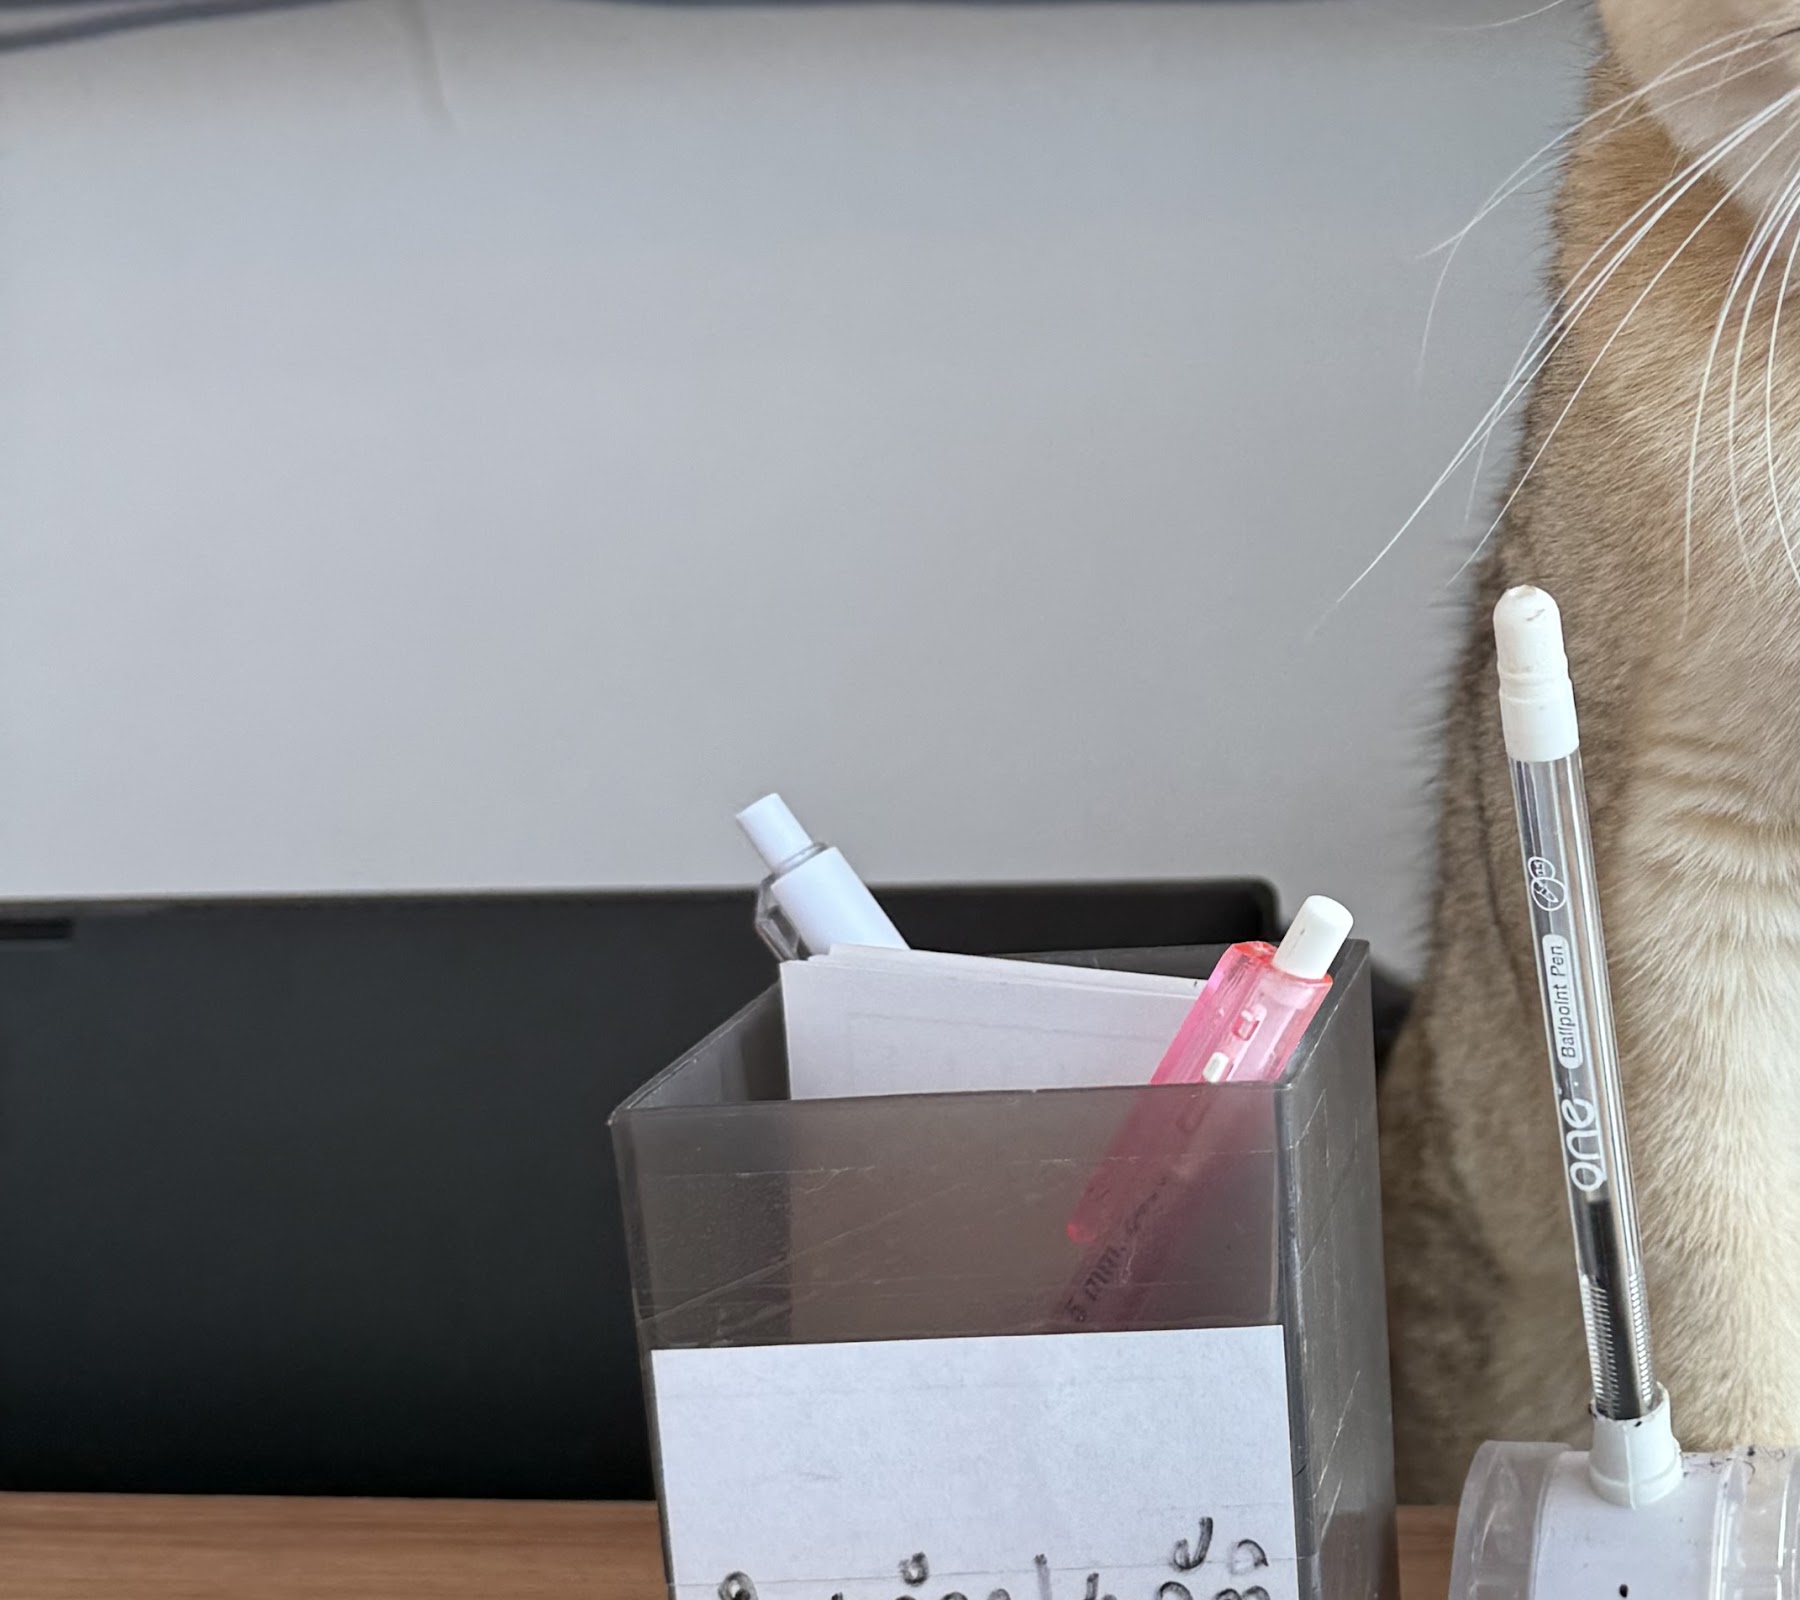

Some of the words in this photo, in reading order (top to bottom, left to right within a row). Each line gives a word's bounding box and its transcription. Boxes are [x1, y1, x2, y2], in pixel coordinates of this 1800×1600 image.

[1551, 945, 1566, 977] Pen
[1553, 984, 1576, 1058] Ballpoint
[1562, 1098, 1606, 1192] one
